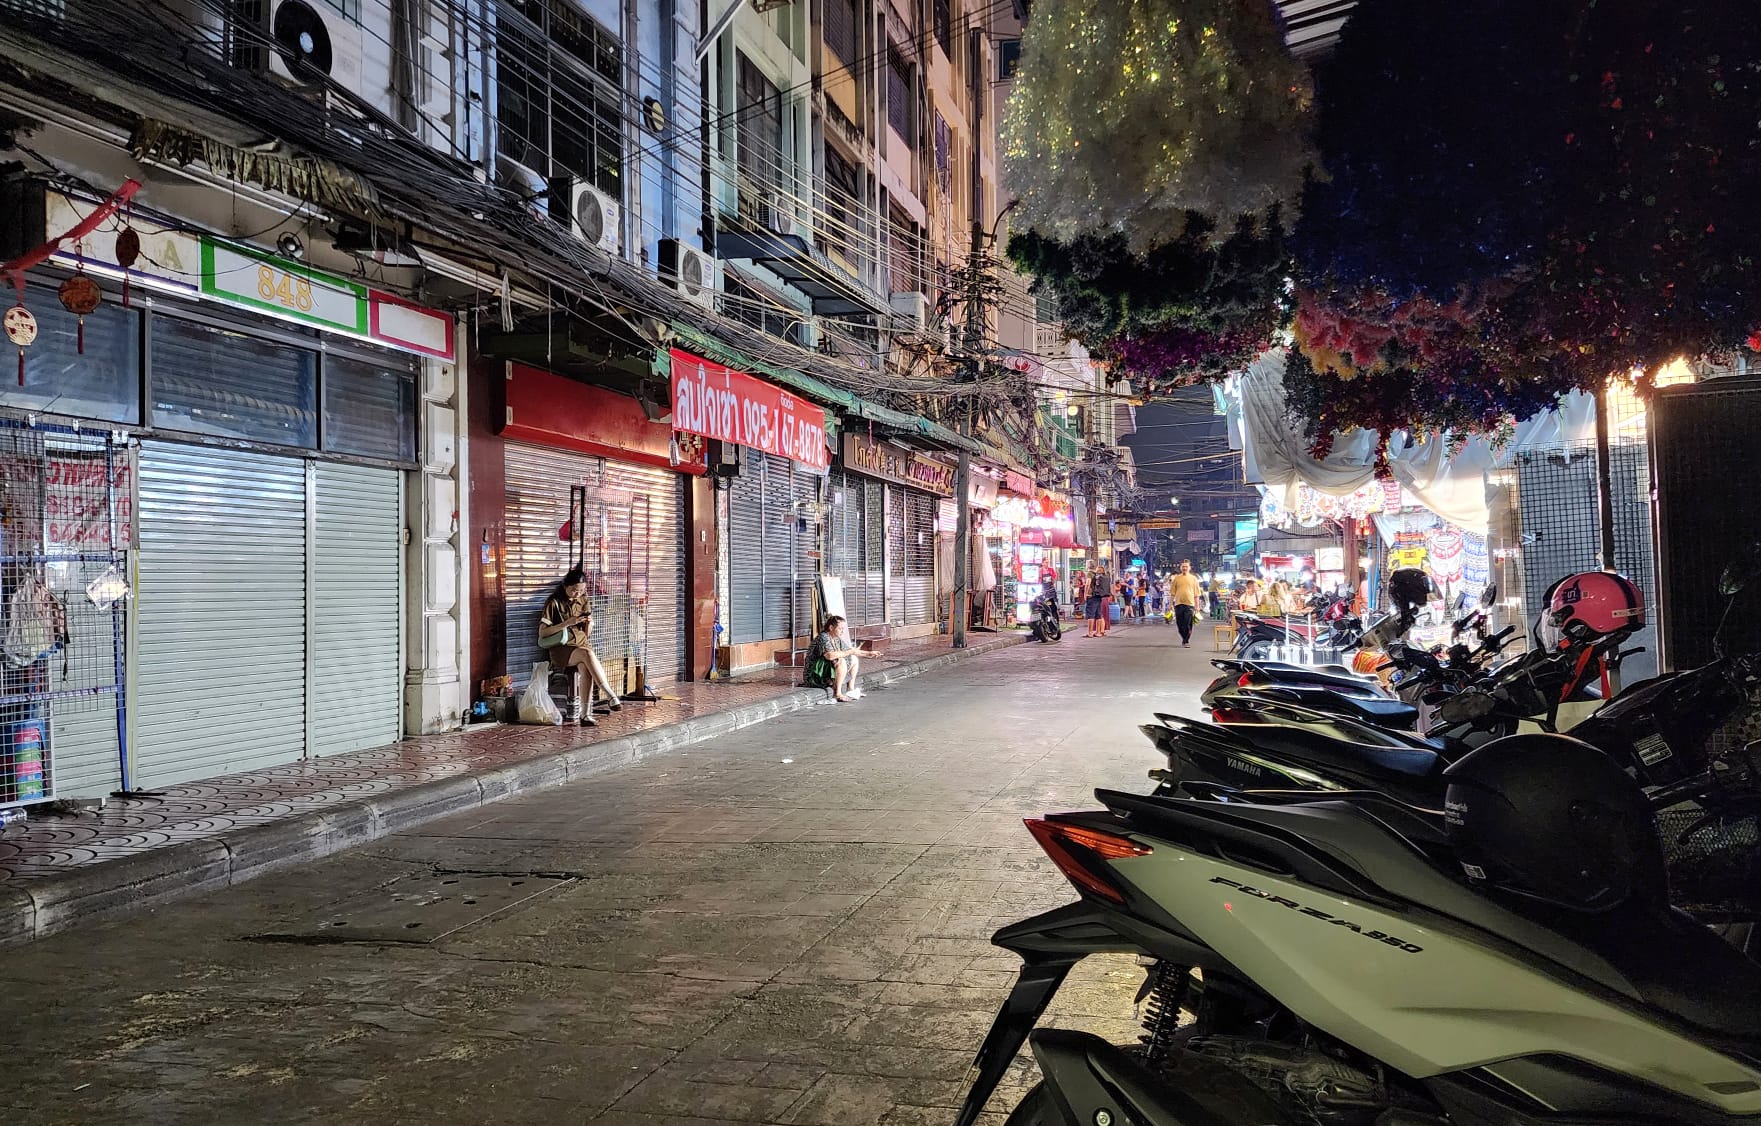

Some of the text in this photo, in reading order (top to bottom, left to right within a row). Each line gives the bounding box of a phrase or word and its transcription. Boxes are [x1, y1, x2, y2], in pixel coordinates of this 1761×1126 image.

[258, 265, 313, 312] 848
[676, 362, 740, 441] สนใจเช่า
[1226, 757, 1261, 777] YAMAHA
